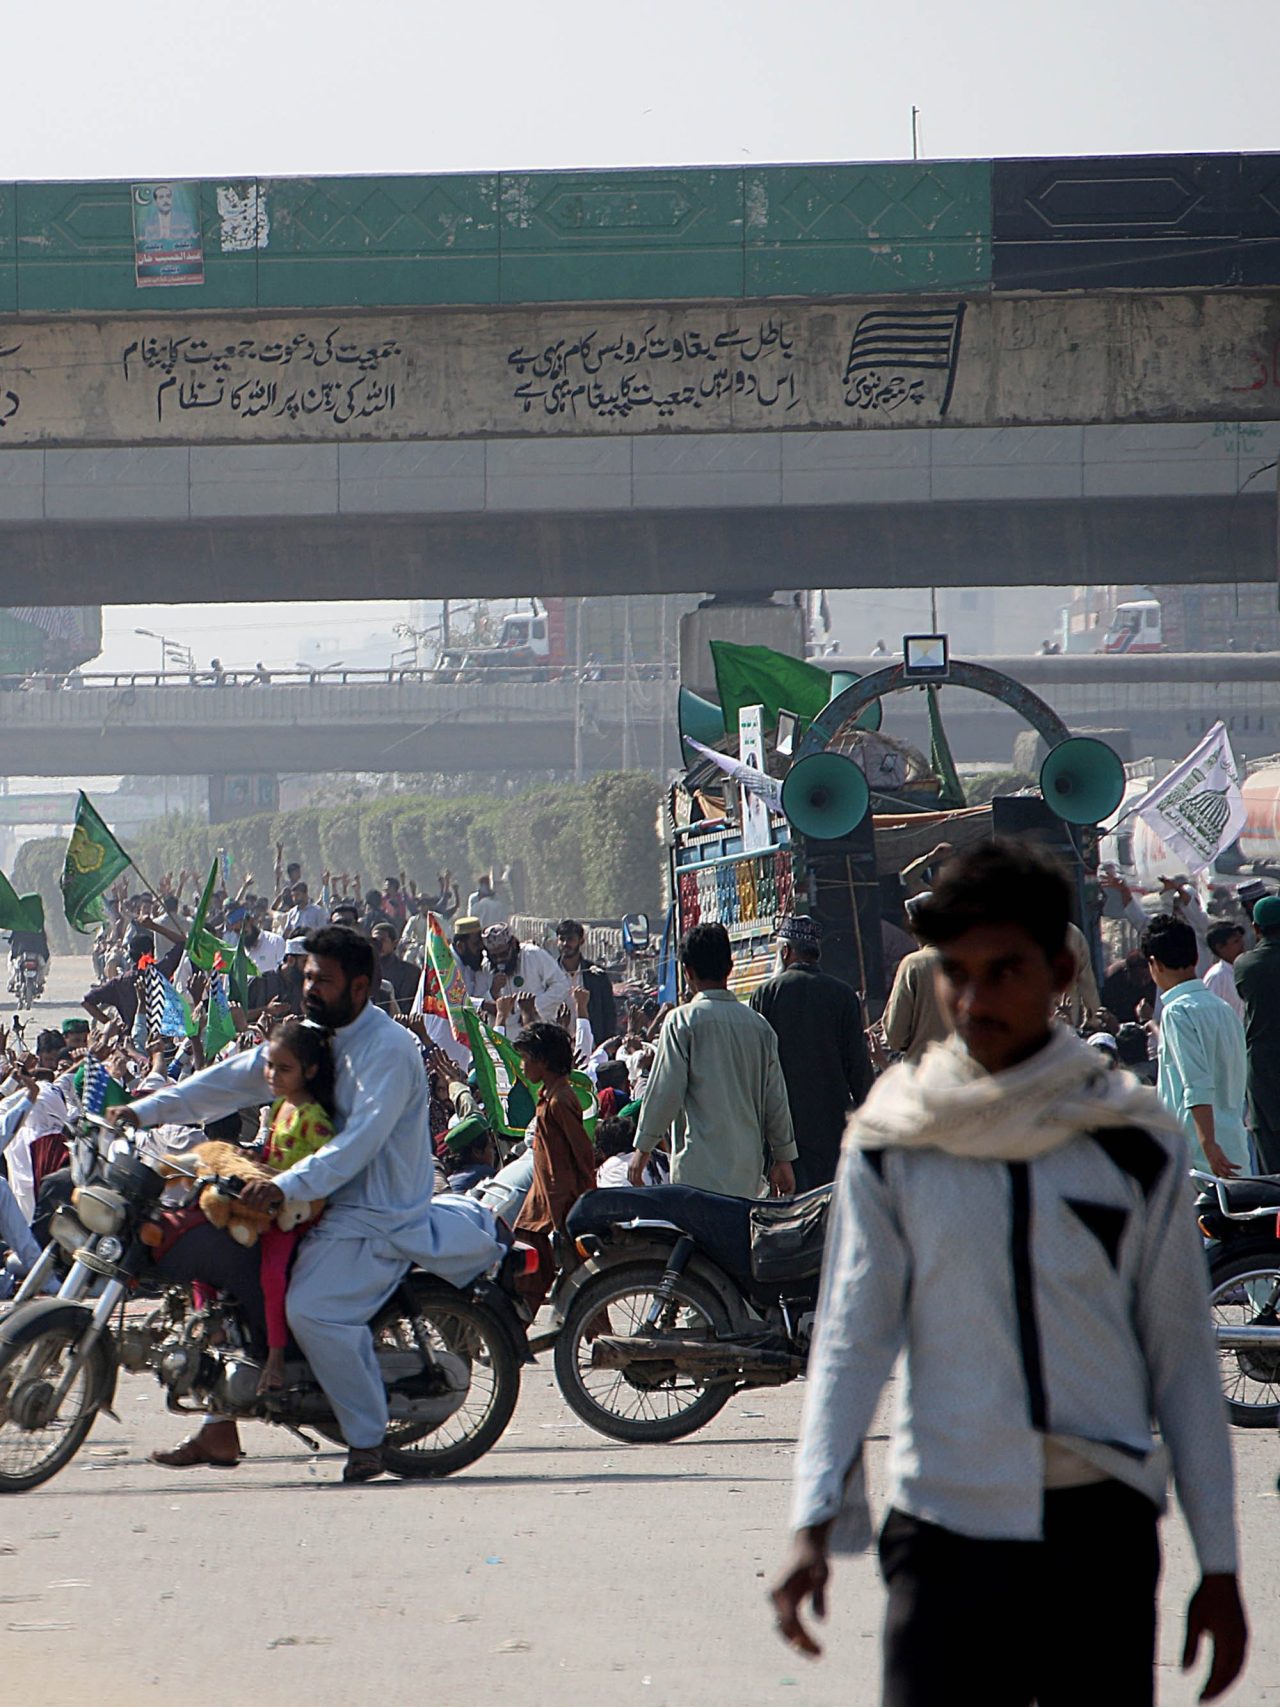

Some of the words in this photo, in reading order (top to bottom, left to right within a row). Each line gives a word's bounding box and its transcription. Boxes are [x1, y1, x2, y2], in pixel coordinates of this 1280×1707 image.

[168, 335, 192, 364] کا
[259, 333, 314, 365] دعوت
[313, 326, 340, 366] کی
[564, 330, 598, 376] کام
[647, 330, 717, 363] بغاوت
[714, 328, 753, 347] سے
[123, 336, 173, 381] پیغام
[184, 339, 258, 372] جمعیت
[336, 339, 401, 371] جمعیت
[508, 345, 539, 374] ہے
[158, 376, 226, 423] نظام
[230, 379, 253, 410] کا
[240, 379, 277, 419] اللہ
[355, 380, 396, 418] اللہ
[514, 380, 547, 413] ہے
[722, 370, 757, 397] دور
[273, 387, 299, 420] پر
[333, 376, 366, 425] کی
[627, 384, 703, 417] جمعیت
